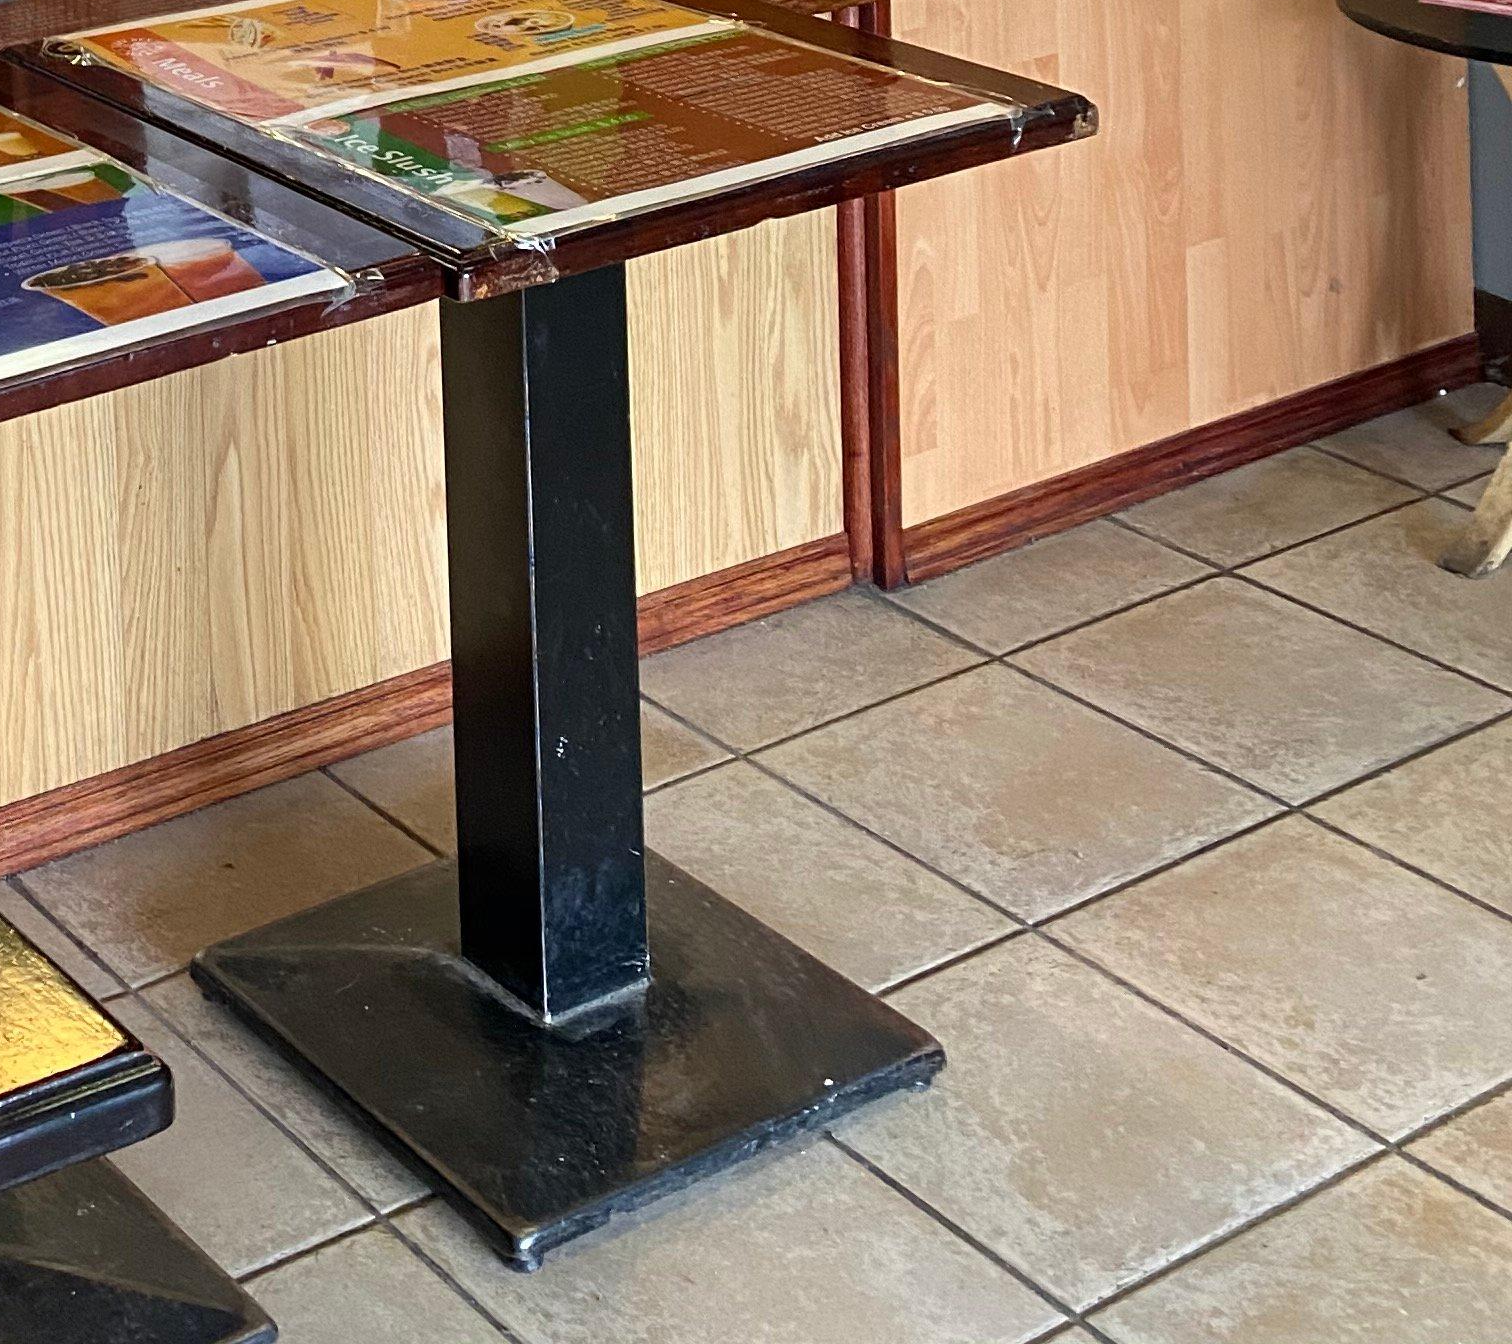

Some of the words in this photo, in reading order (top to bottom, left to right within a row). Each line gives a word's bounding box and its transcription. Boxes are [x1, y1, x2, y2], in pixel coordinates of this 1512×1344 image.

[152, 58, 224, 89] Meals
[335, 133, 377, 155] Ice
[377, 149, 454, 184] Slush
